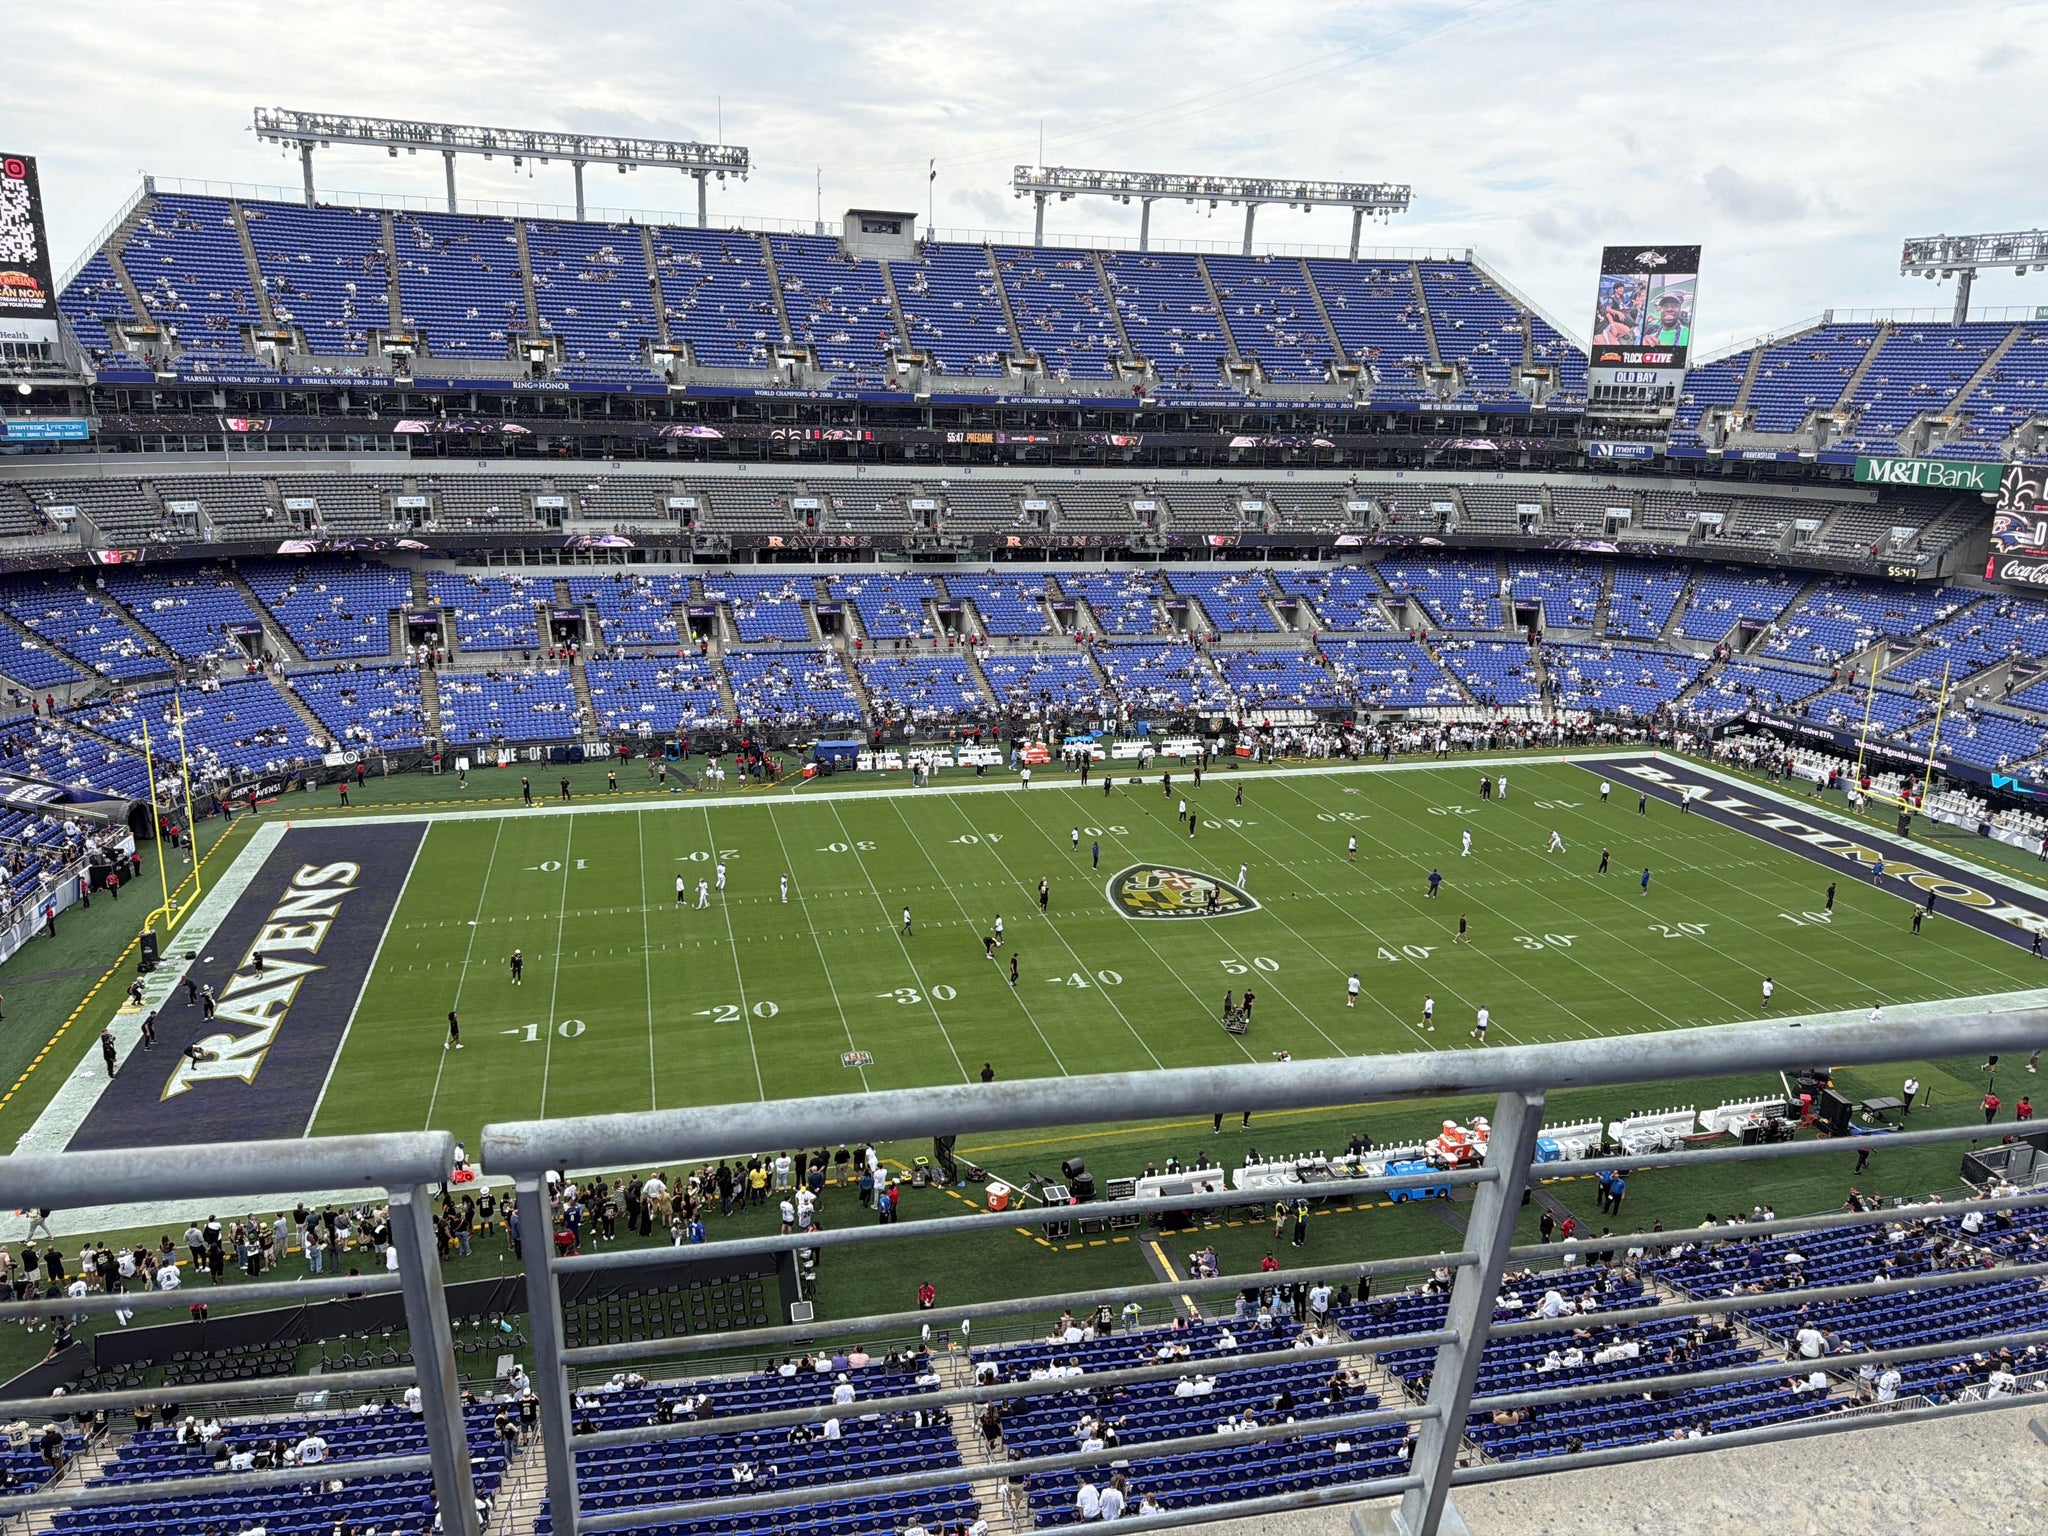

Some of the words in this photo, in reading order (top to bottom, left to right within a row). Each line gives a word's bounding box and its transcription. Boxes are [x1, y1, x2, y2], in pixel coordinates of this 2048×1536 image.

[19, 289, 45, 298] NOW
[0, 331, 29, 340] Health
[1623, 353, 1643, 363] FLOCK
[1652, 353, 1673, 363] LIVE
[183, 375, 216, 383] MARSHAL
[1616, 372, 1635, 382] OLD
[1637, 372, 1655, 383] BAY
[513, 381, 533, 389] RING
[538, 382, 570, 390] HONOR
[947, 433, 964, 443] 55:47
[966, 433, 994, 443] PREGAME
[1615, 445, 1646, 454] merritt
[1866, 459, 1926, 484] M&T
[1926, 463, 1985, 489] Bank
[767, 535, 873, 547] RAVENS
[1006, 535, 1101, 547] RAVENS
[1888, 566, 1916, 578] 55:47
[1089, 722, 1099, 730] EST
[1103, 720, 1117, 731] 19
[1819, 730, 1835, 740] ETFs
[477, 747, 517, 764] HME
[529, 746, 541, 760] OF
[1882, 747, 1908, 760] signals
[1908, 752, 1924, 764] into
[255, 783, 281, 798] AVENS!
[1778, 911, 1832, 926] 10
[1648, 922, 1706, 938] 20
[1514, 932, 1571, 951] 30
[1377, 944, 1432, 963] 40
[1220, 956, 1280, 975] 50
[160, 861, 360, 1102] RAVENS
[1065, 968, 1123, 989] 40
[896, 984, 957, 1005] 30
[712, 1000, 779, 1024] 20
[520, 1019, 586, 1043] 10
[1454, 1147, 1464, 1157] G
[989, 1196, 998, 1206] G
[166, 1274, 172, 1282] 8
[75, 1289, 82, 1297] 8
[1283, 1288, 1290, 1296] 5
[1299, 1285, 1305, 1293] 8
[1320, 1295, 1326, 1303] 8
[1100, 1311, 1111, 1323] 12
[1999, 1381, 2013, 1393] 22
[10, 1431, 23, 1442] 12
[307, 1447, 317, 1457] 91
